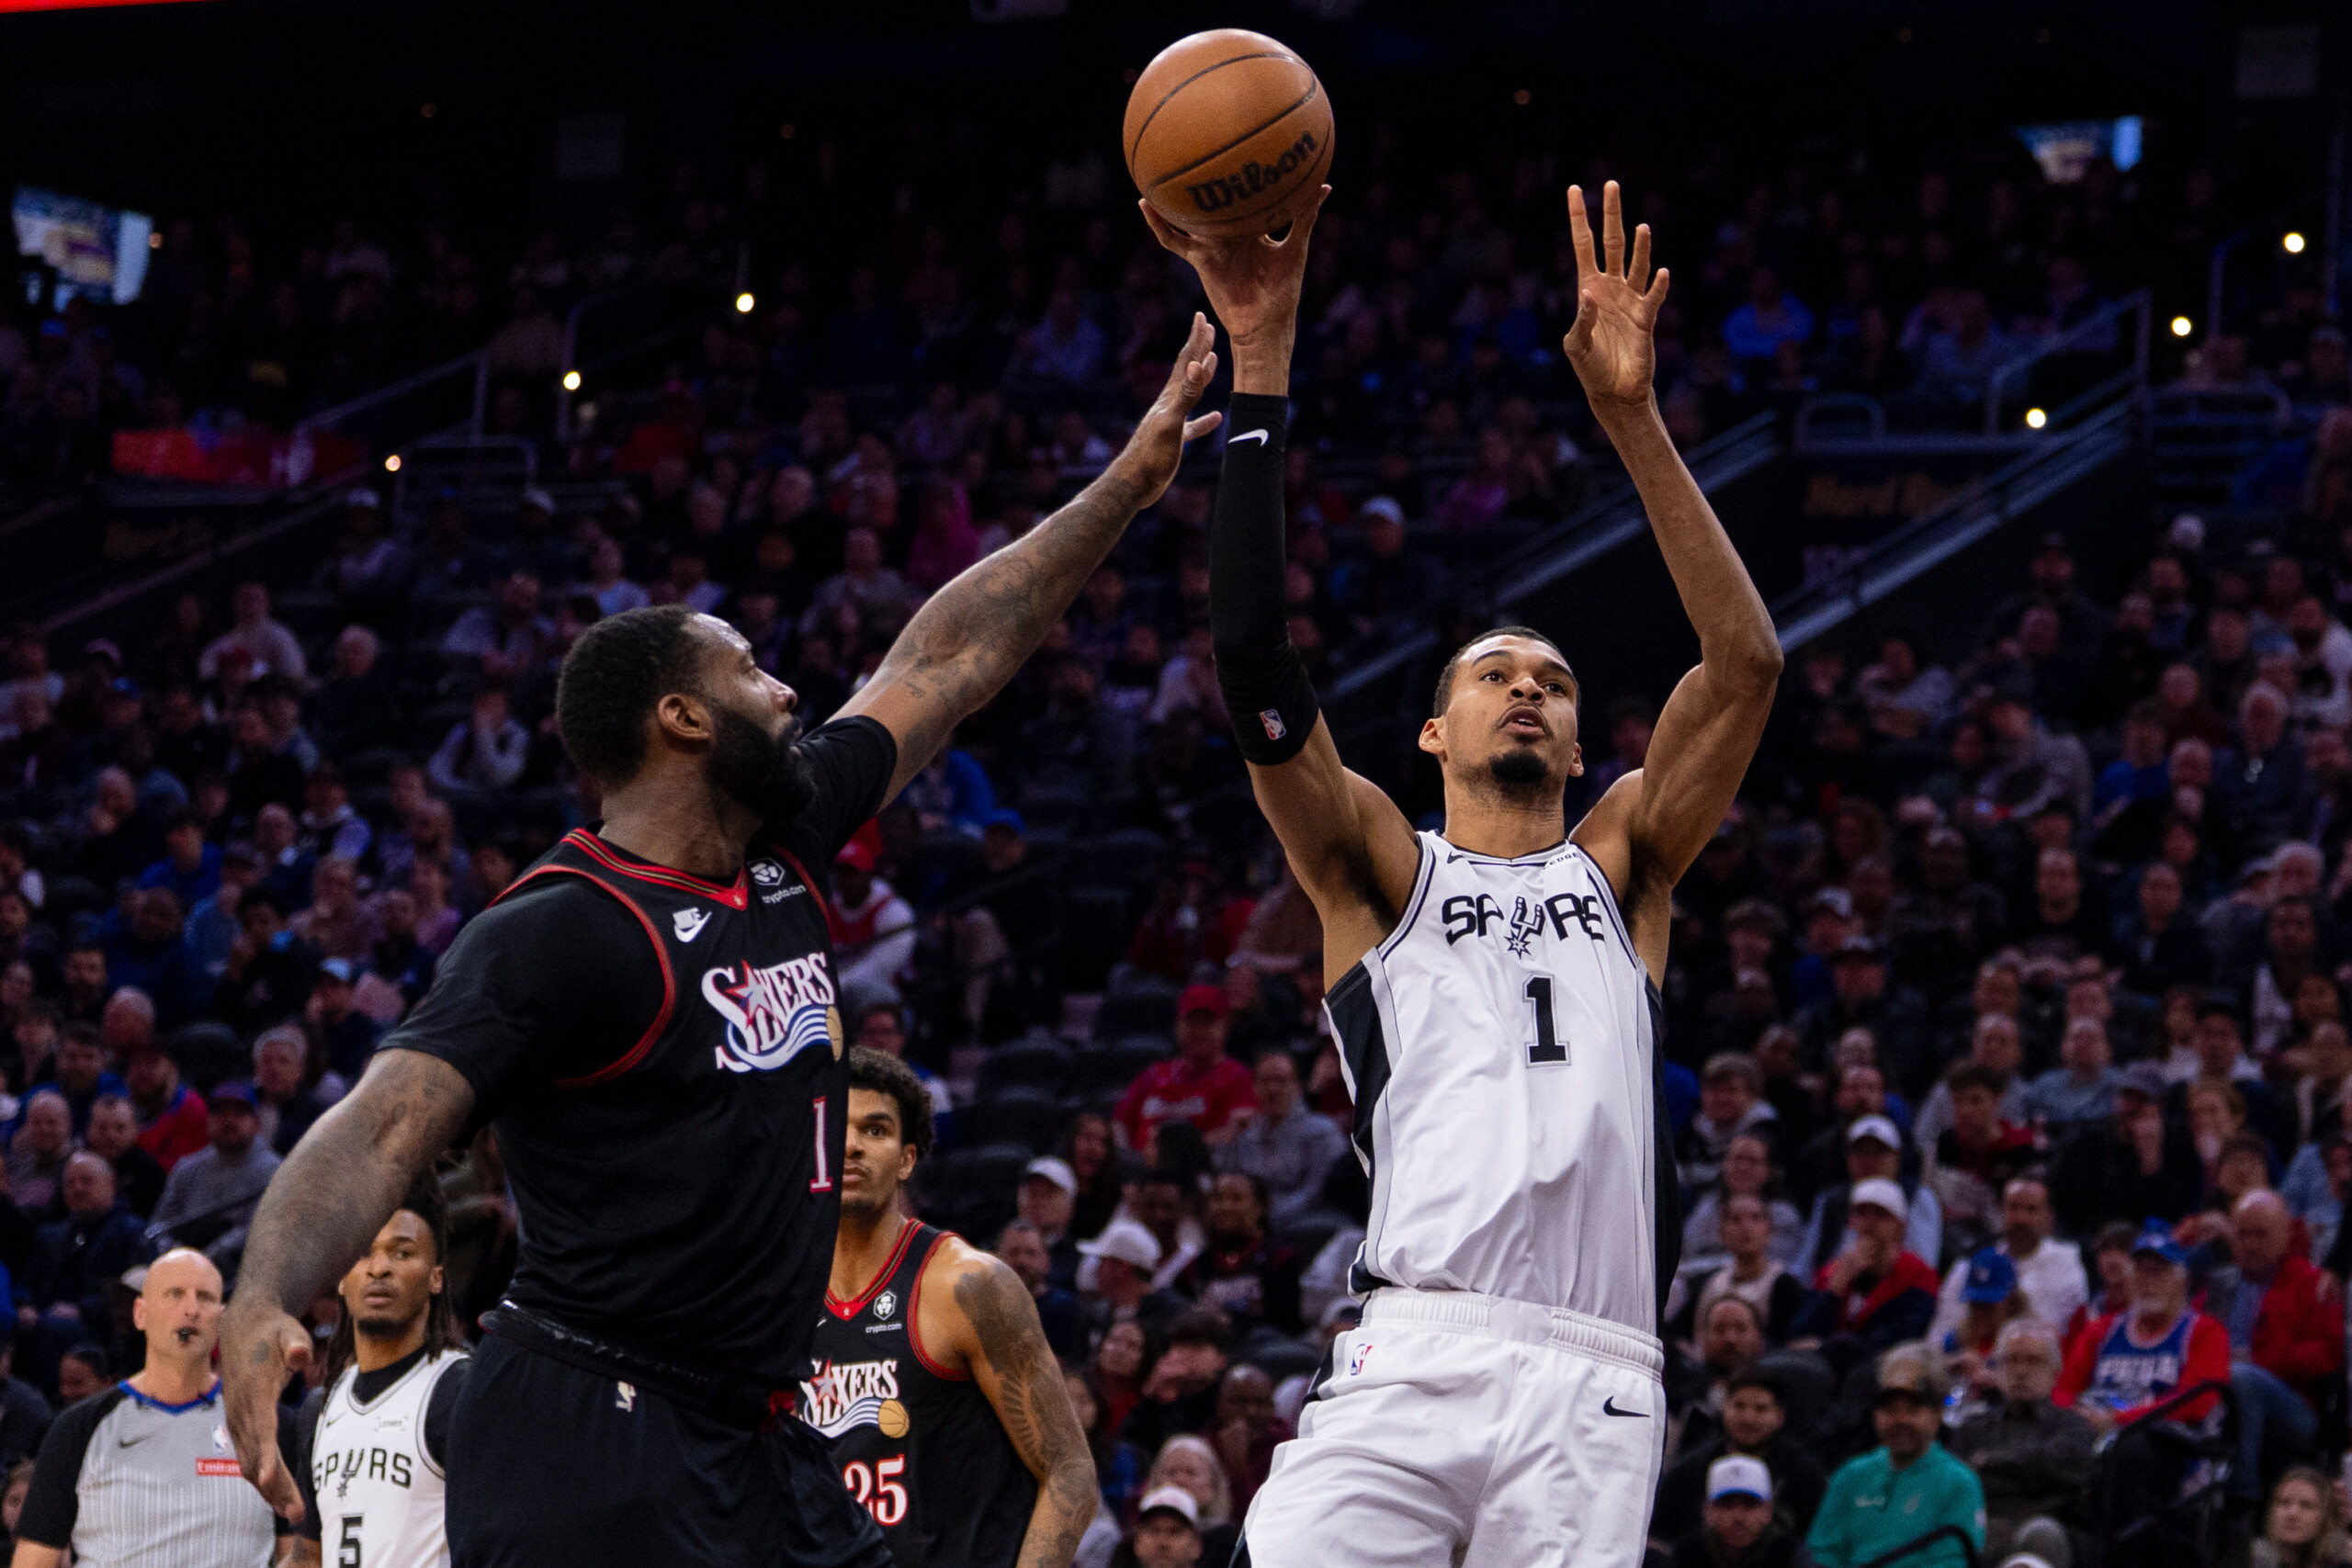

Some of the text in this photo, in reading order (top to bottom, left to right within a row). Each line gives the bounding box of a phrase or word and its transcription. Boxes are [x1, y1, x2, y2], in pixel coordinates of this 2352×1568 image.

[1186, 130, 1317, 212] Wilson
[1442, 893, 1605, 958] SPURS
[1522, 974, 1571, 1068] 1
[809, 1095, 832, 1193] 1
[865, 1323, 902, 1334] crypto.com
[313, 1448, 413, 1500] SPURS
[843, 1454, 908, 1527] 25
[338, 1514, 366, 1568] 5
